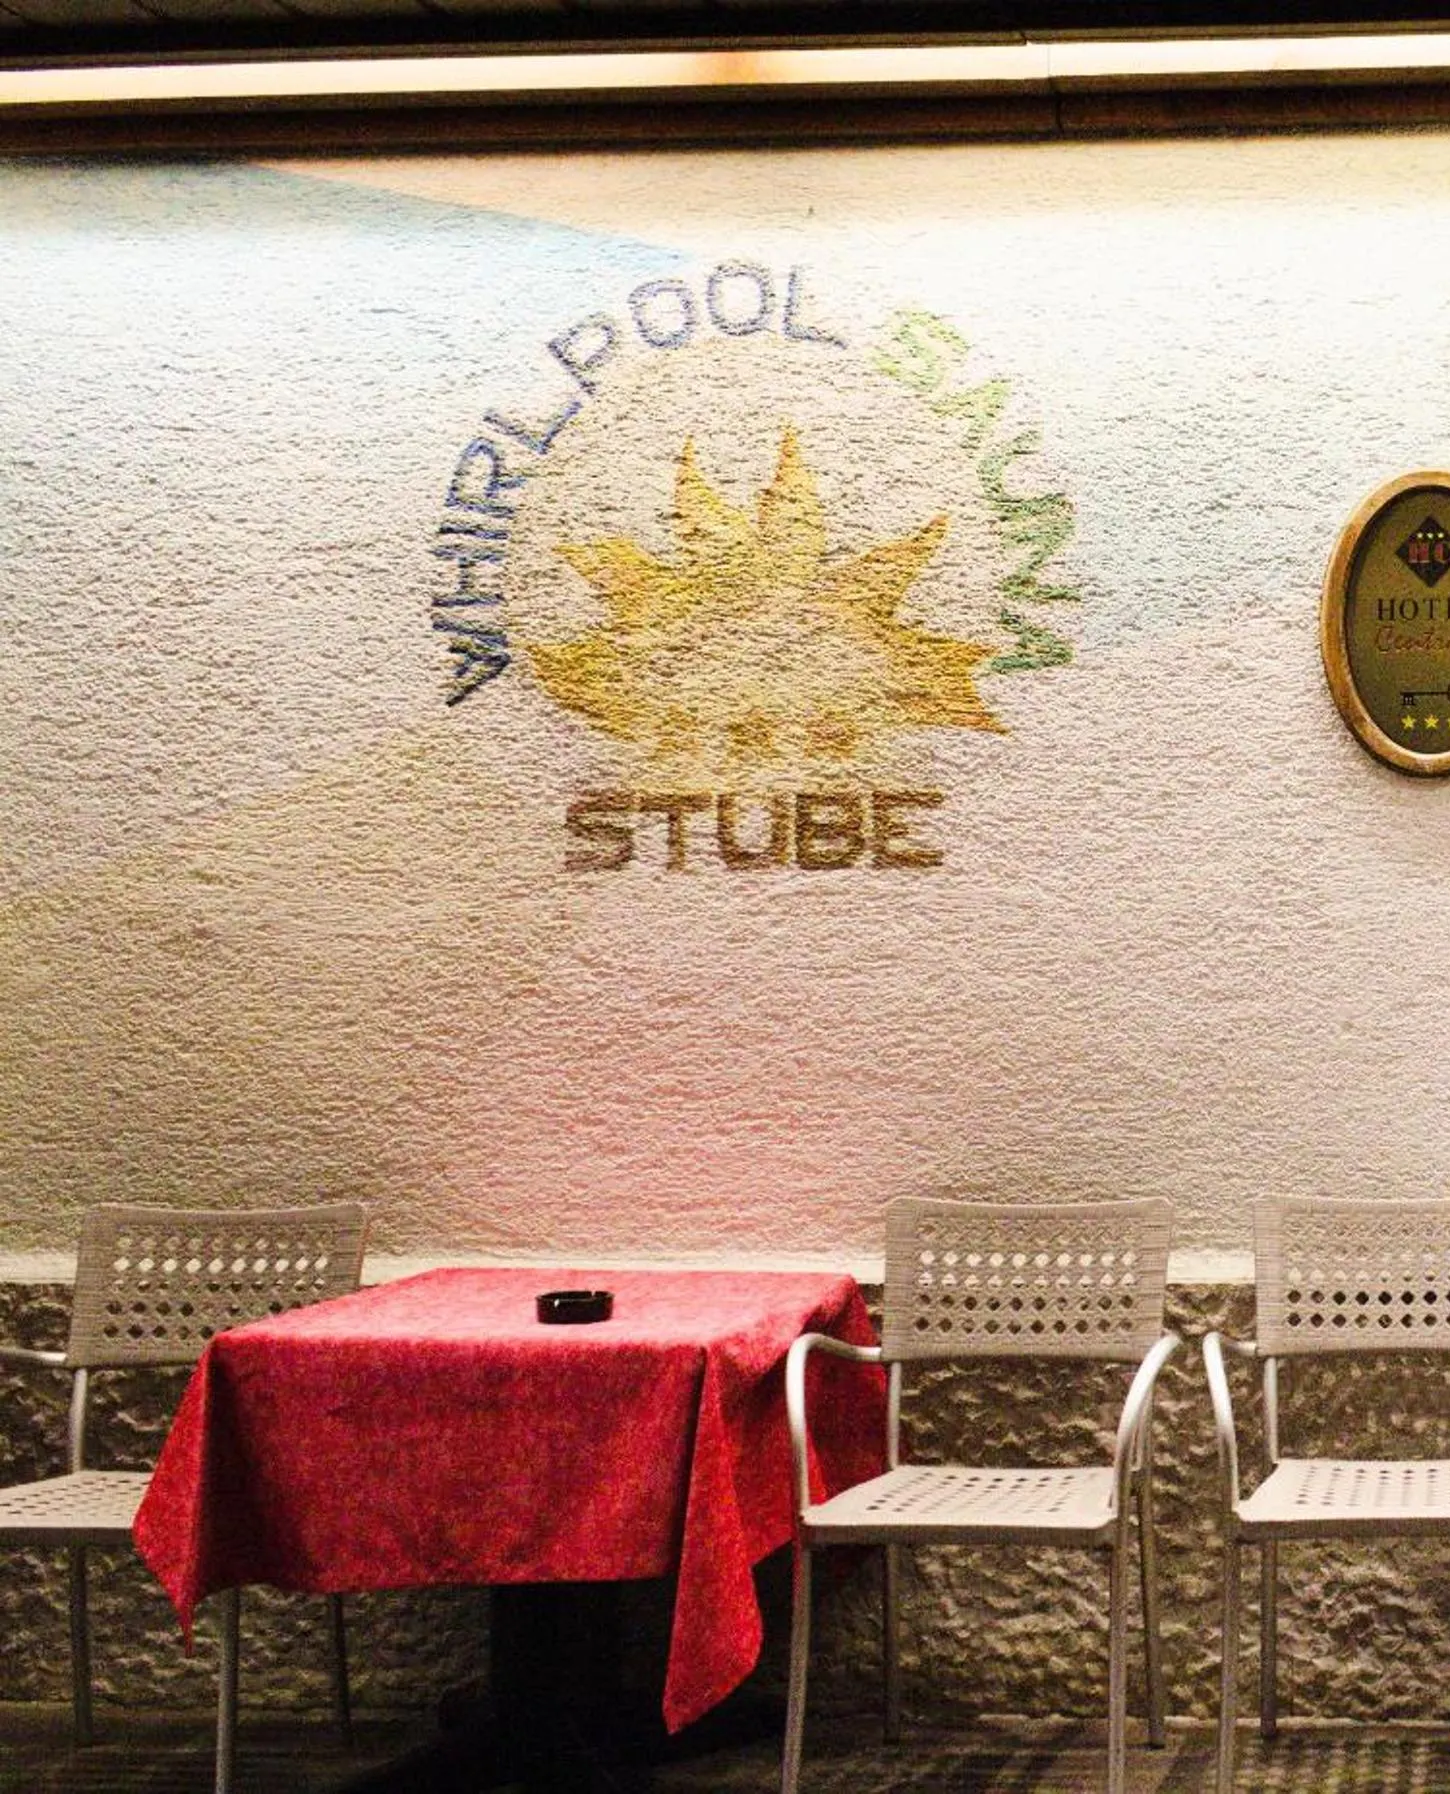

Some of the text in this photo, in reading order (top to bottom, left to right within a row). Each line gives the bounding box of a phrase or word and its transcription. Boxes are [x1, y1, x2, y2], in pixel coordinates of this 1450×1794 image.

[430, 258, 1082, 707] WHIRLPOOL SAUNA
[564, 789, 944, 872] STUBE
